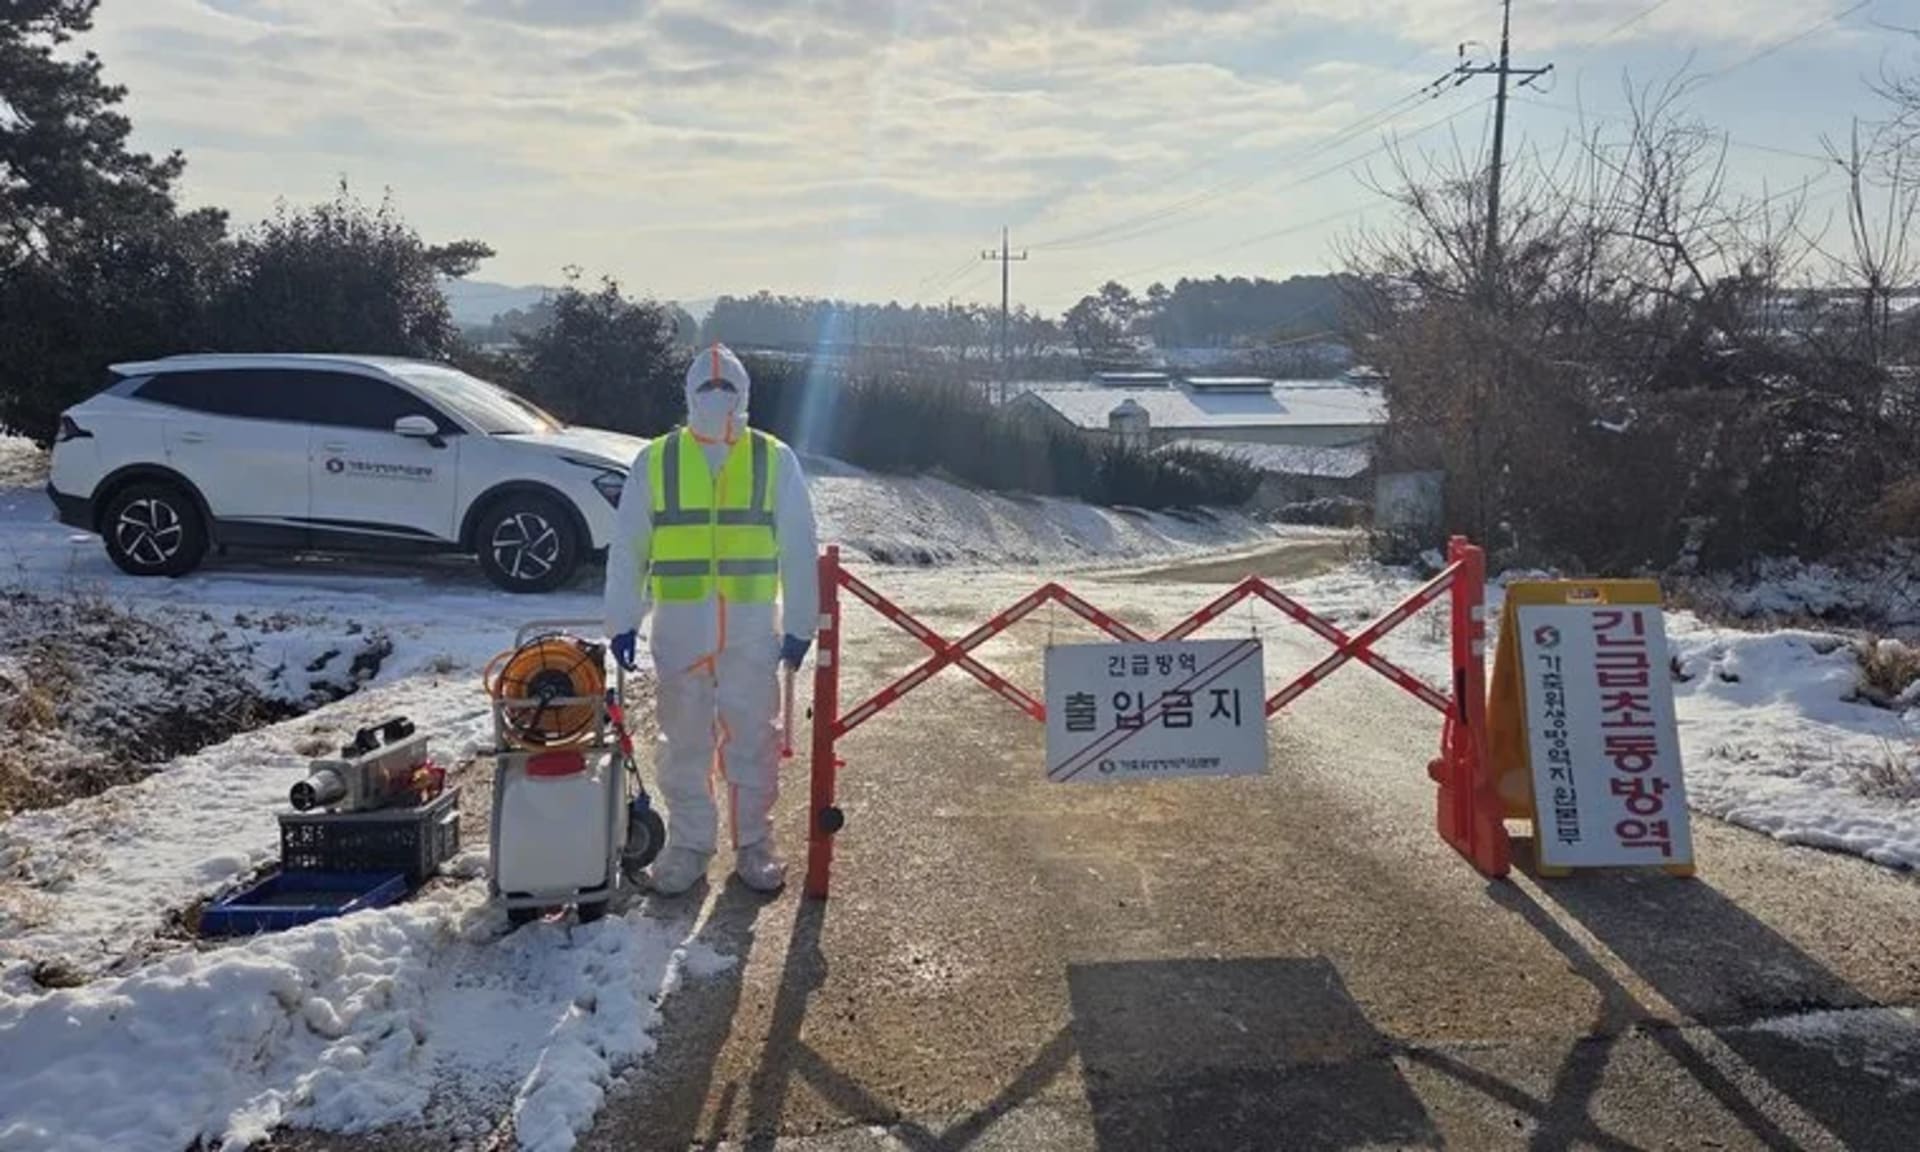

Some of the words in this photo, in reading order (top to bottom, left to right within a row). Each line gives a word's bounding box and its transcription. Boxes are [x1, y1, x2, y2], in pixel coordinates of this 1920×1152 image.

[1108, 653, 1197, 677] 긴급방역
[1064, 688, 1242, 733] 출입금지
[1592, 611, 1673, 857] 긴급초동방역
